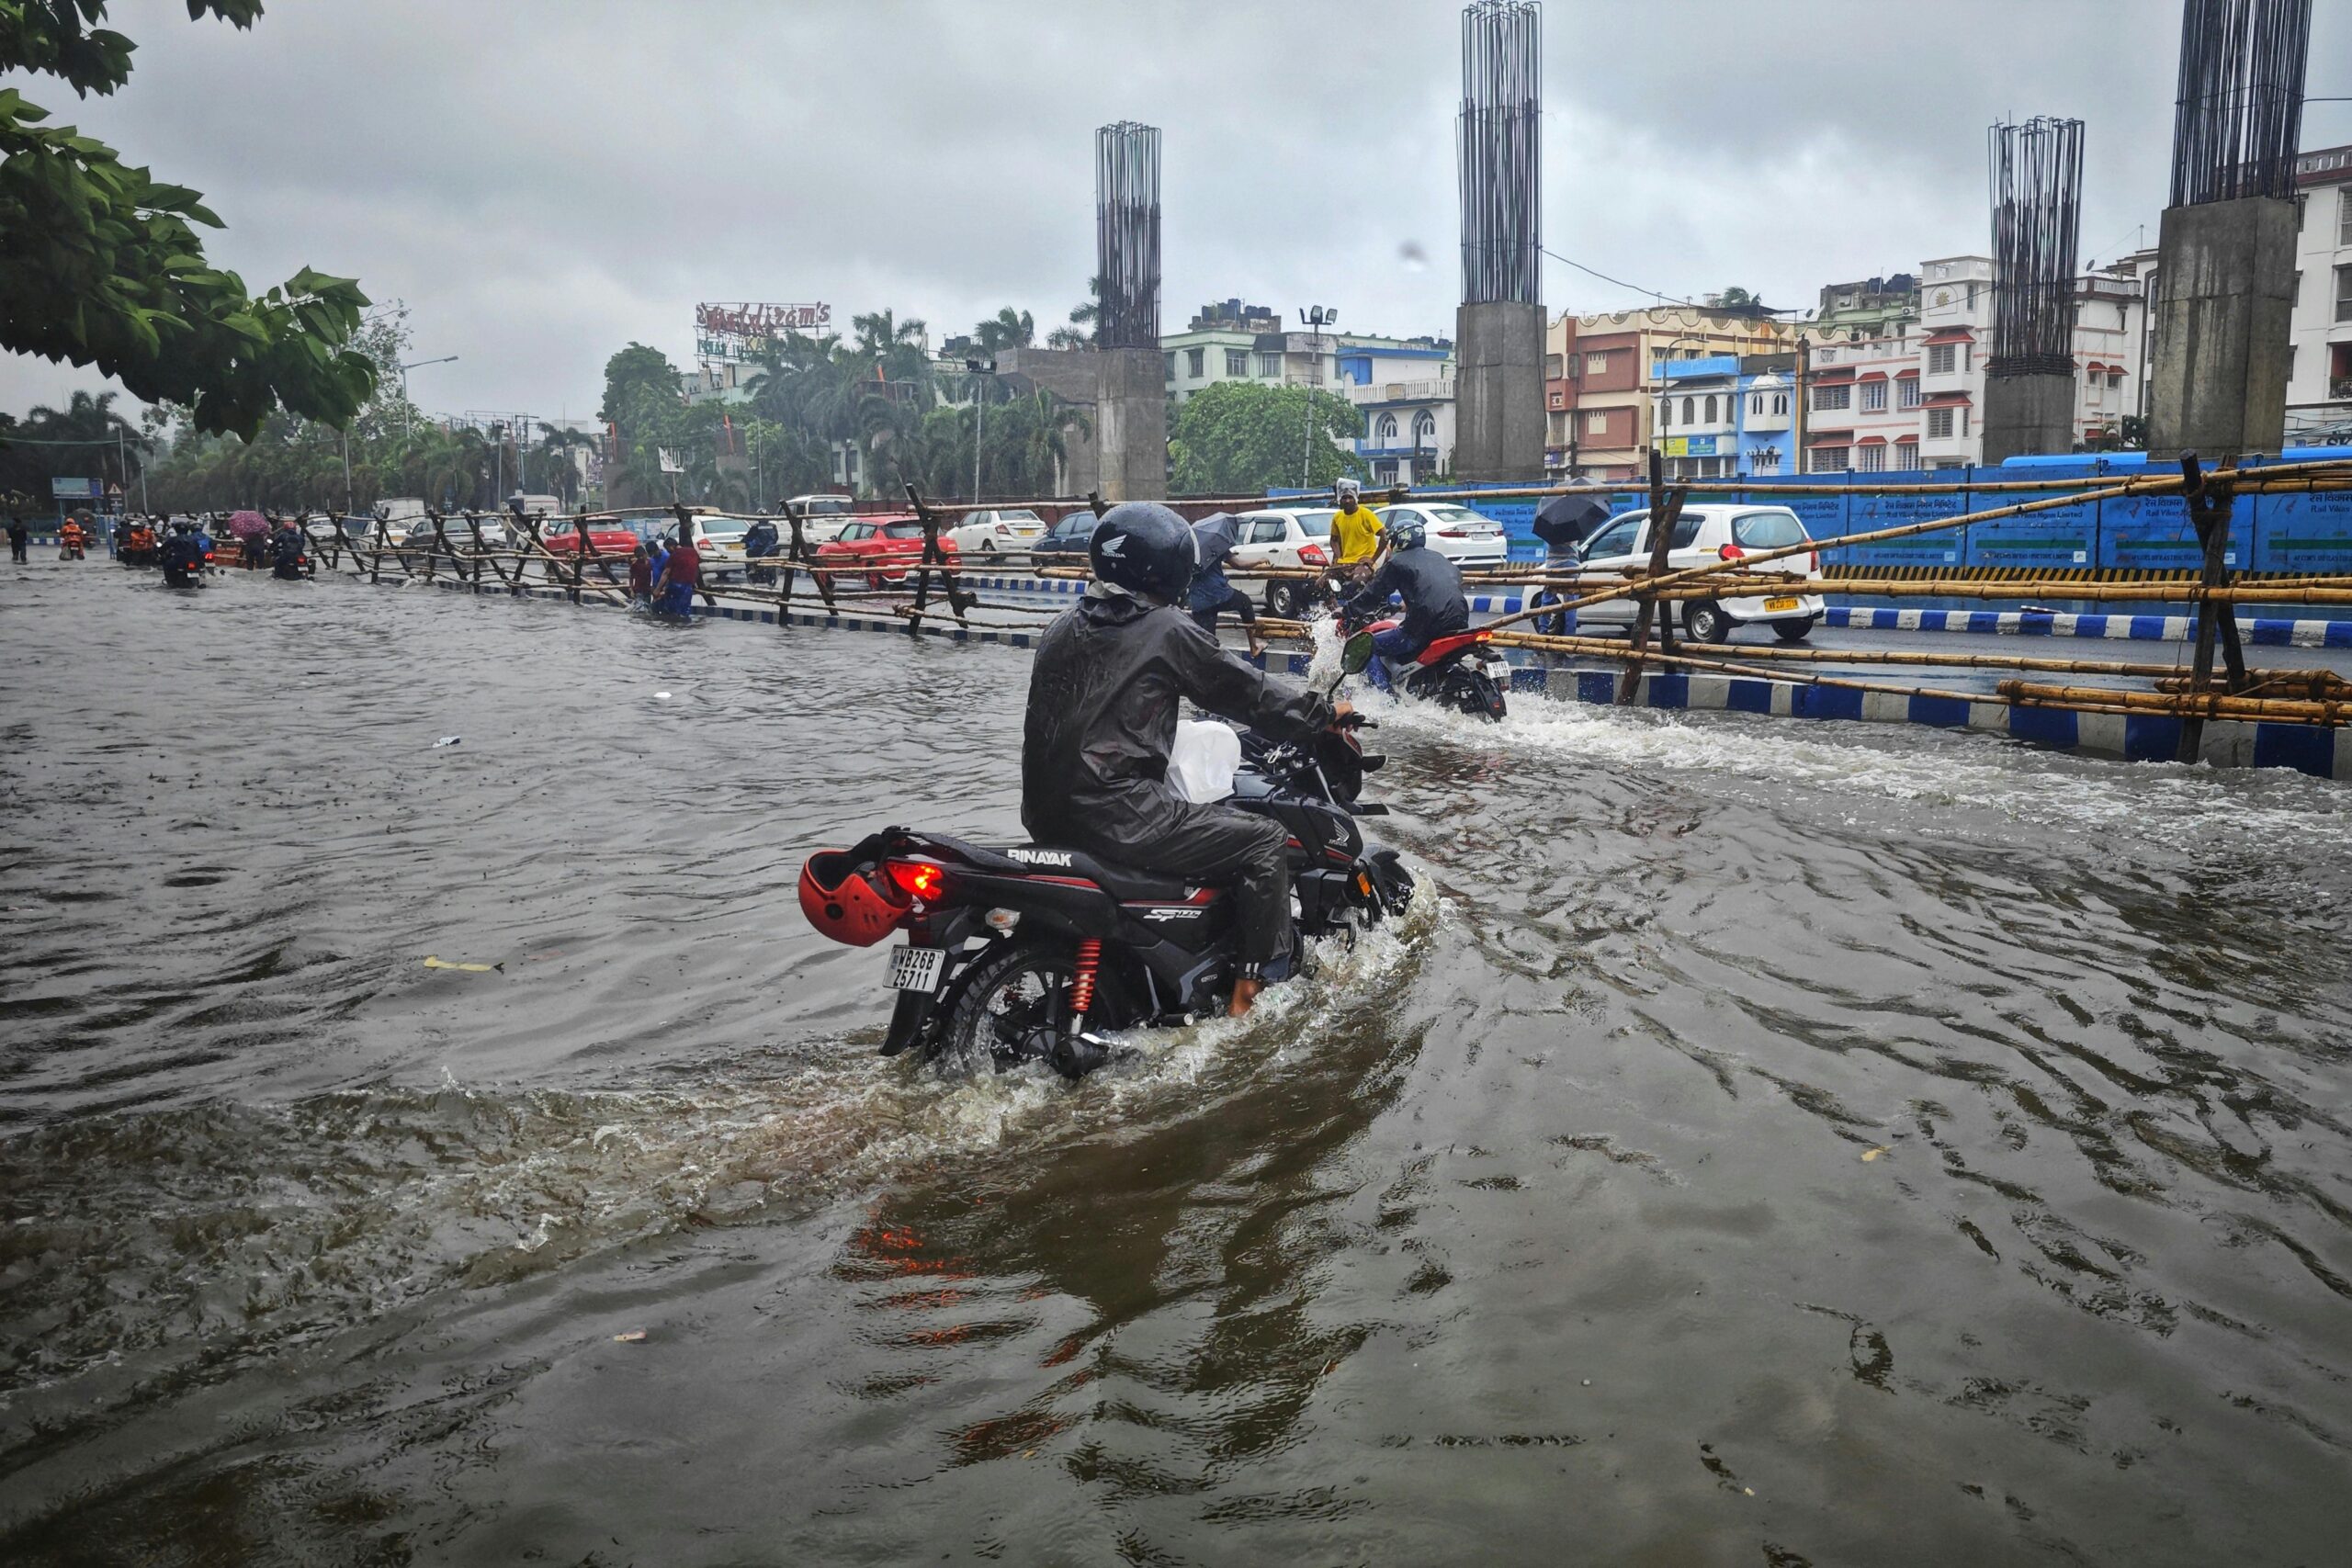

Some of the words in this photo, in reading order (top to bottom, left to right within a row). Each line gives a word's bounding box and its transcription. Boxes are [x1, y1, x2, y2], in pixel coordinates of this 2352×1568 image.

[1007, 849, 1072, 867] BINAYAK
[899, 949, 936, 971] WB26B
[893, 968, 930, 989] Z5711
